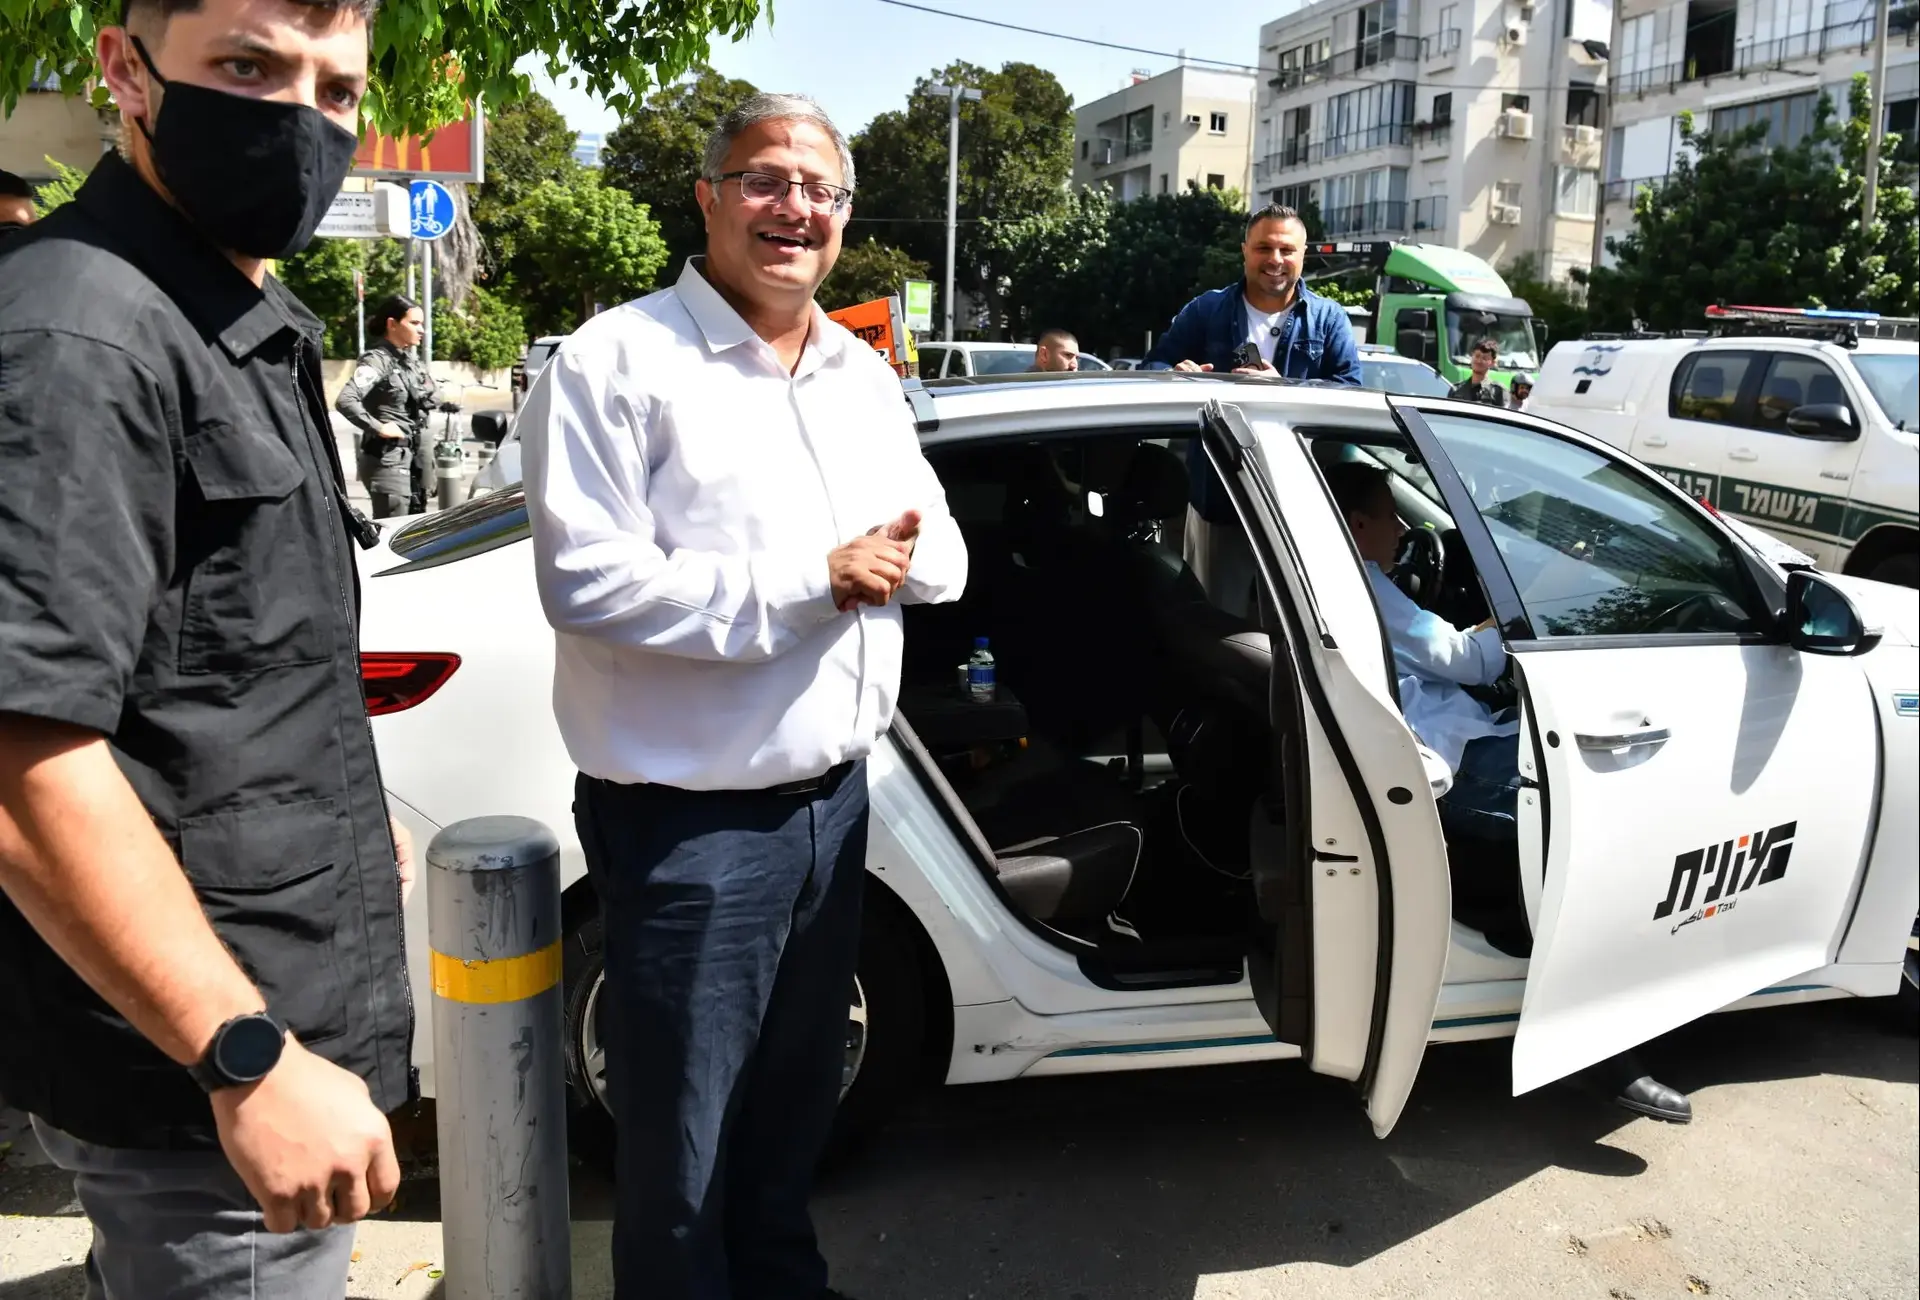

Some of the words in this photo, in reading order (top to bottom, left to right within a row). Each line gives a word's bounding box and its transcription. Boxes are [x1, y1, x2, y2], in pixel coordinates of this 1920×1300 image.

[1734, 484, 1818, 524] משמר
[1653, 820, 1798, 921] מונית
[1717, 898, 1738, 914] Taxi
